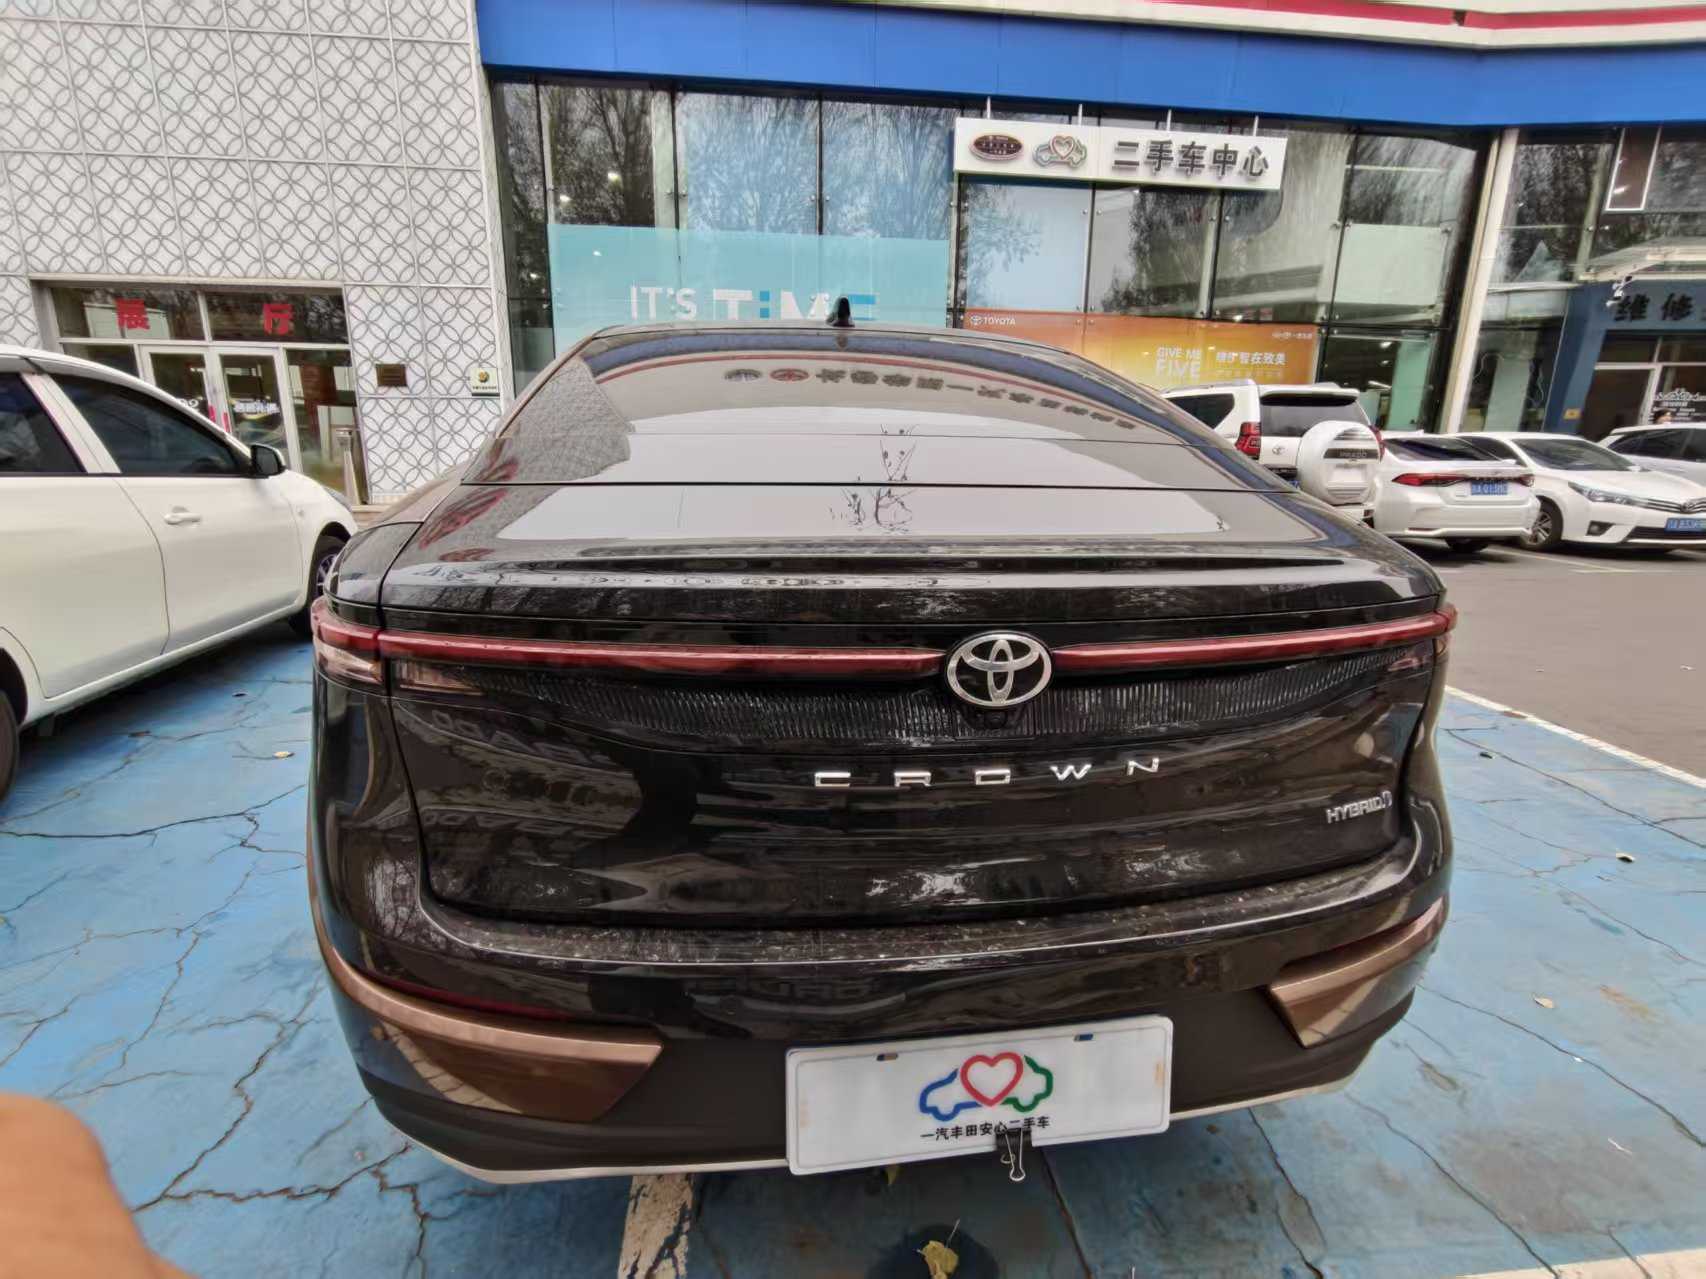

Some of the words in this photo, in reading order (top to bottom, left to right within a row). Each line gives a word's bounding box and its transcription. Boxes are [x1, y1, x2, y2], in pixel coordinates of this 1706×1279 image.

[1113, 138, 1270, 177] 二手车中心
[630, 285, 697, 320] IT'S
[984, 316, 1016, 325] TOYOTA
[1156, 346, 1183, 360] GIVE
[1185, 348, 1201, 361] ME
[1156, 359, 1201, 378] FIVE
[814, 757, 1160, 788] CROWN
[1325, 795, 1383, 824] HYBRID
